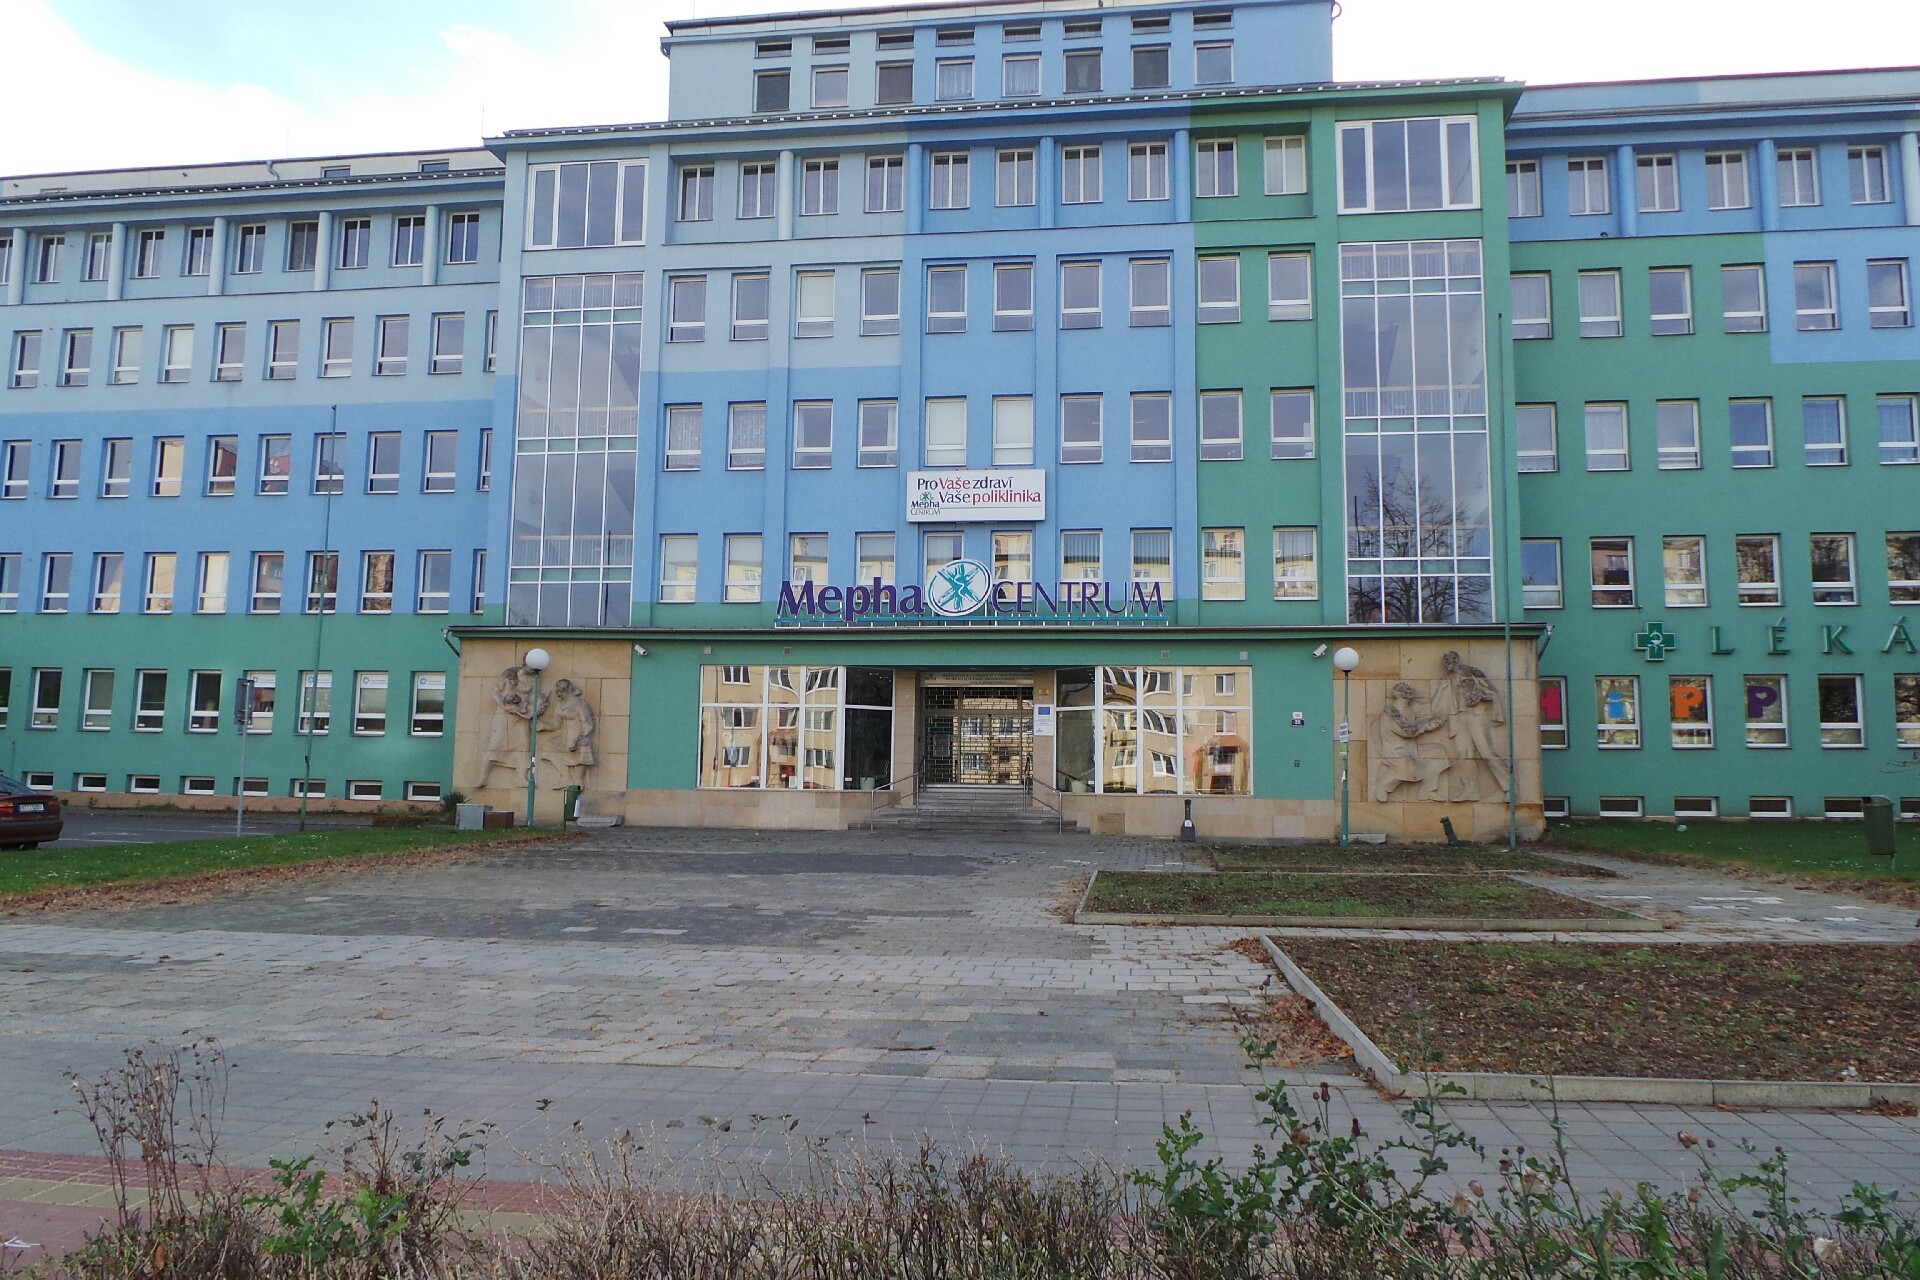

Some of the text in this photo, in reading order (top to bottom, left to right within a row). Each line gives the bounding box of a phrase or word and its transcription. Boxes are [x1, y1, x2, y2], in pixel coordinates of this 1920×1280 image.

[917, 476, 1014, 490] Pro Vaše zdraví
[938, 489, 1041, 505] Vaše poliklinika
[910, 500, 940, 509] Mepha
[910, 508, 940, 516] CENTRUM
[776, 576, 1166, 622] Mepha CENTRUM
